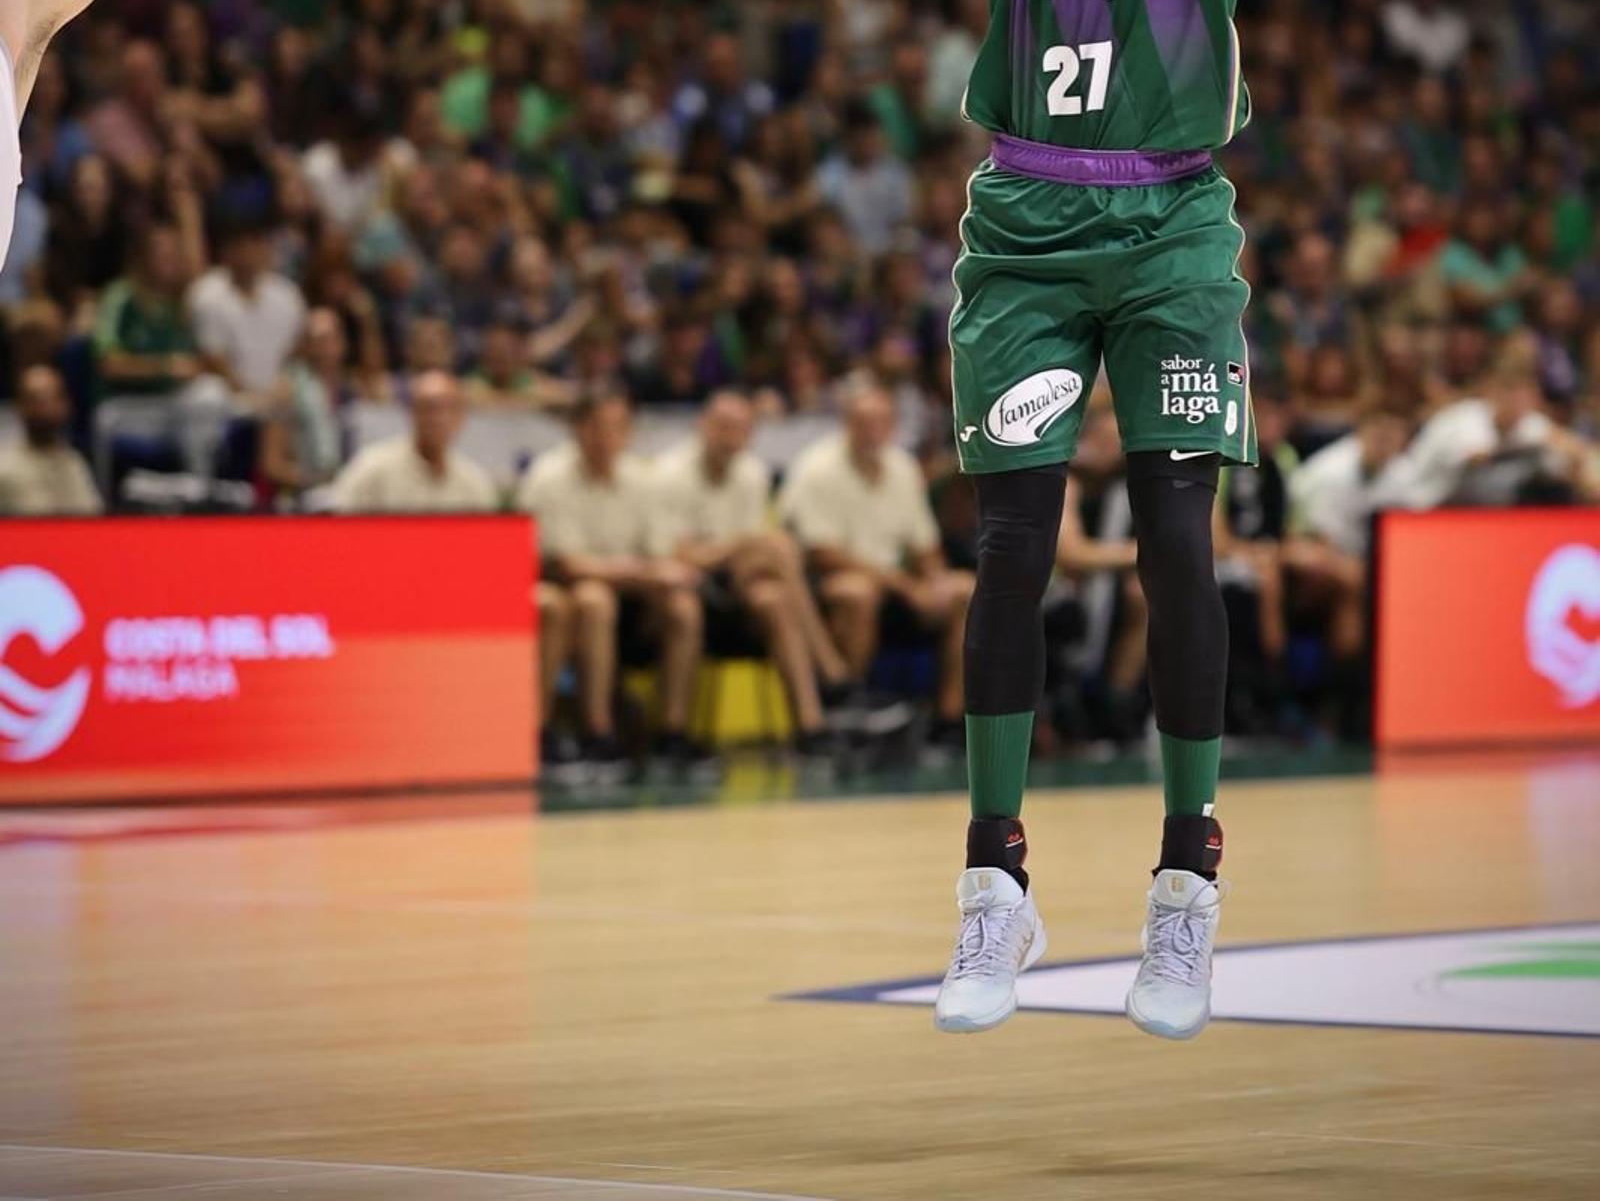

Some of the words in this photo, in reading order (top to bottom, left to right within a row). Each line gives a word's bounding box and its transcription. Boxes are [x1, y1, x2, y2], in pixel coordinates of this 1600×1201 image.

[1043, 41, 1113, 116] 27
[1161, 354, 1203, 370] sabor
[1161, 374, 1170, 385] a
[1171, 364, 1220, 393] má
[998, 377, 1080, 437] famadesa
[1161, 389, 1221, 424] laga
